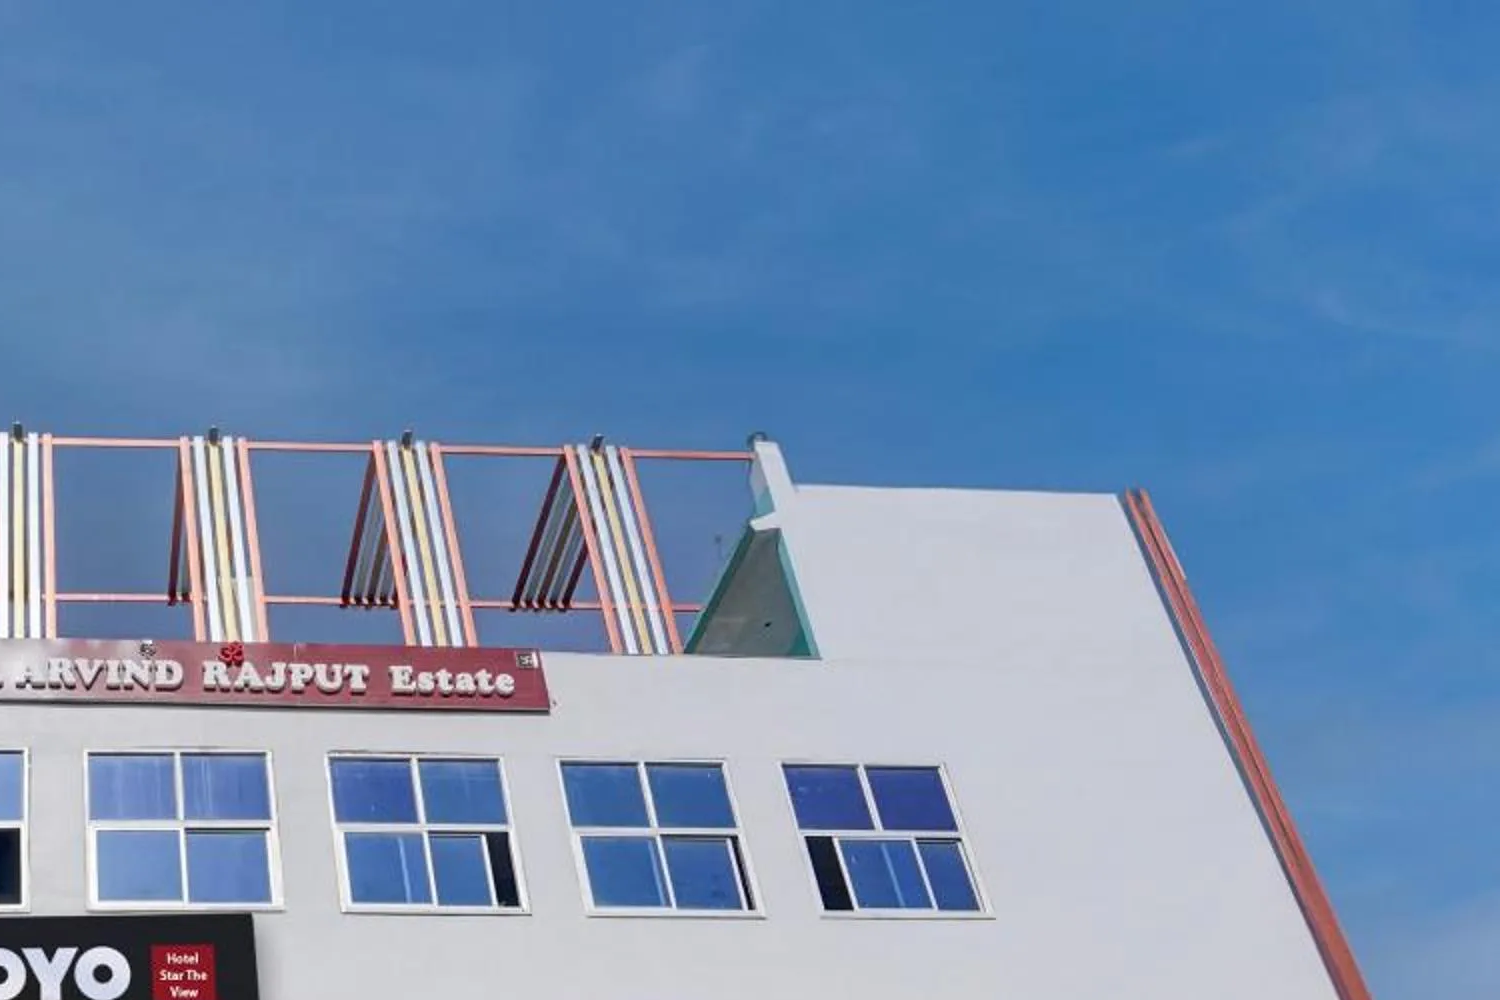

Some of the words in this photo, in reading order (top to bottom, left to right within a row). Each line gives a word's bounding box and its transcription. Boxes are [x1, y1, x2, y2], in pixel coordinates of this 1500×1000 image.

[15, 657, 185, 693] ARVIND
[202, 660, 370, 695] RAJPUT
[388, 665, 516, 698] Estate
[166, 952, 199, 964] Hotel
[159, 969, 184, 981] Star
[186, 969, 208, 981] The
[169, 986, 199, 998] View
